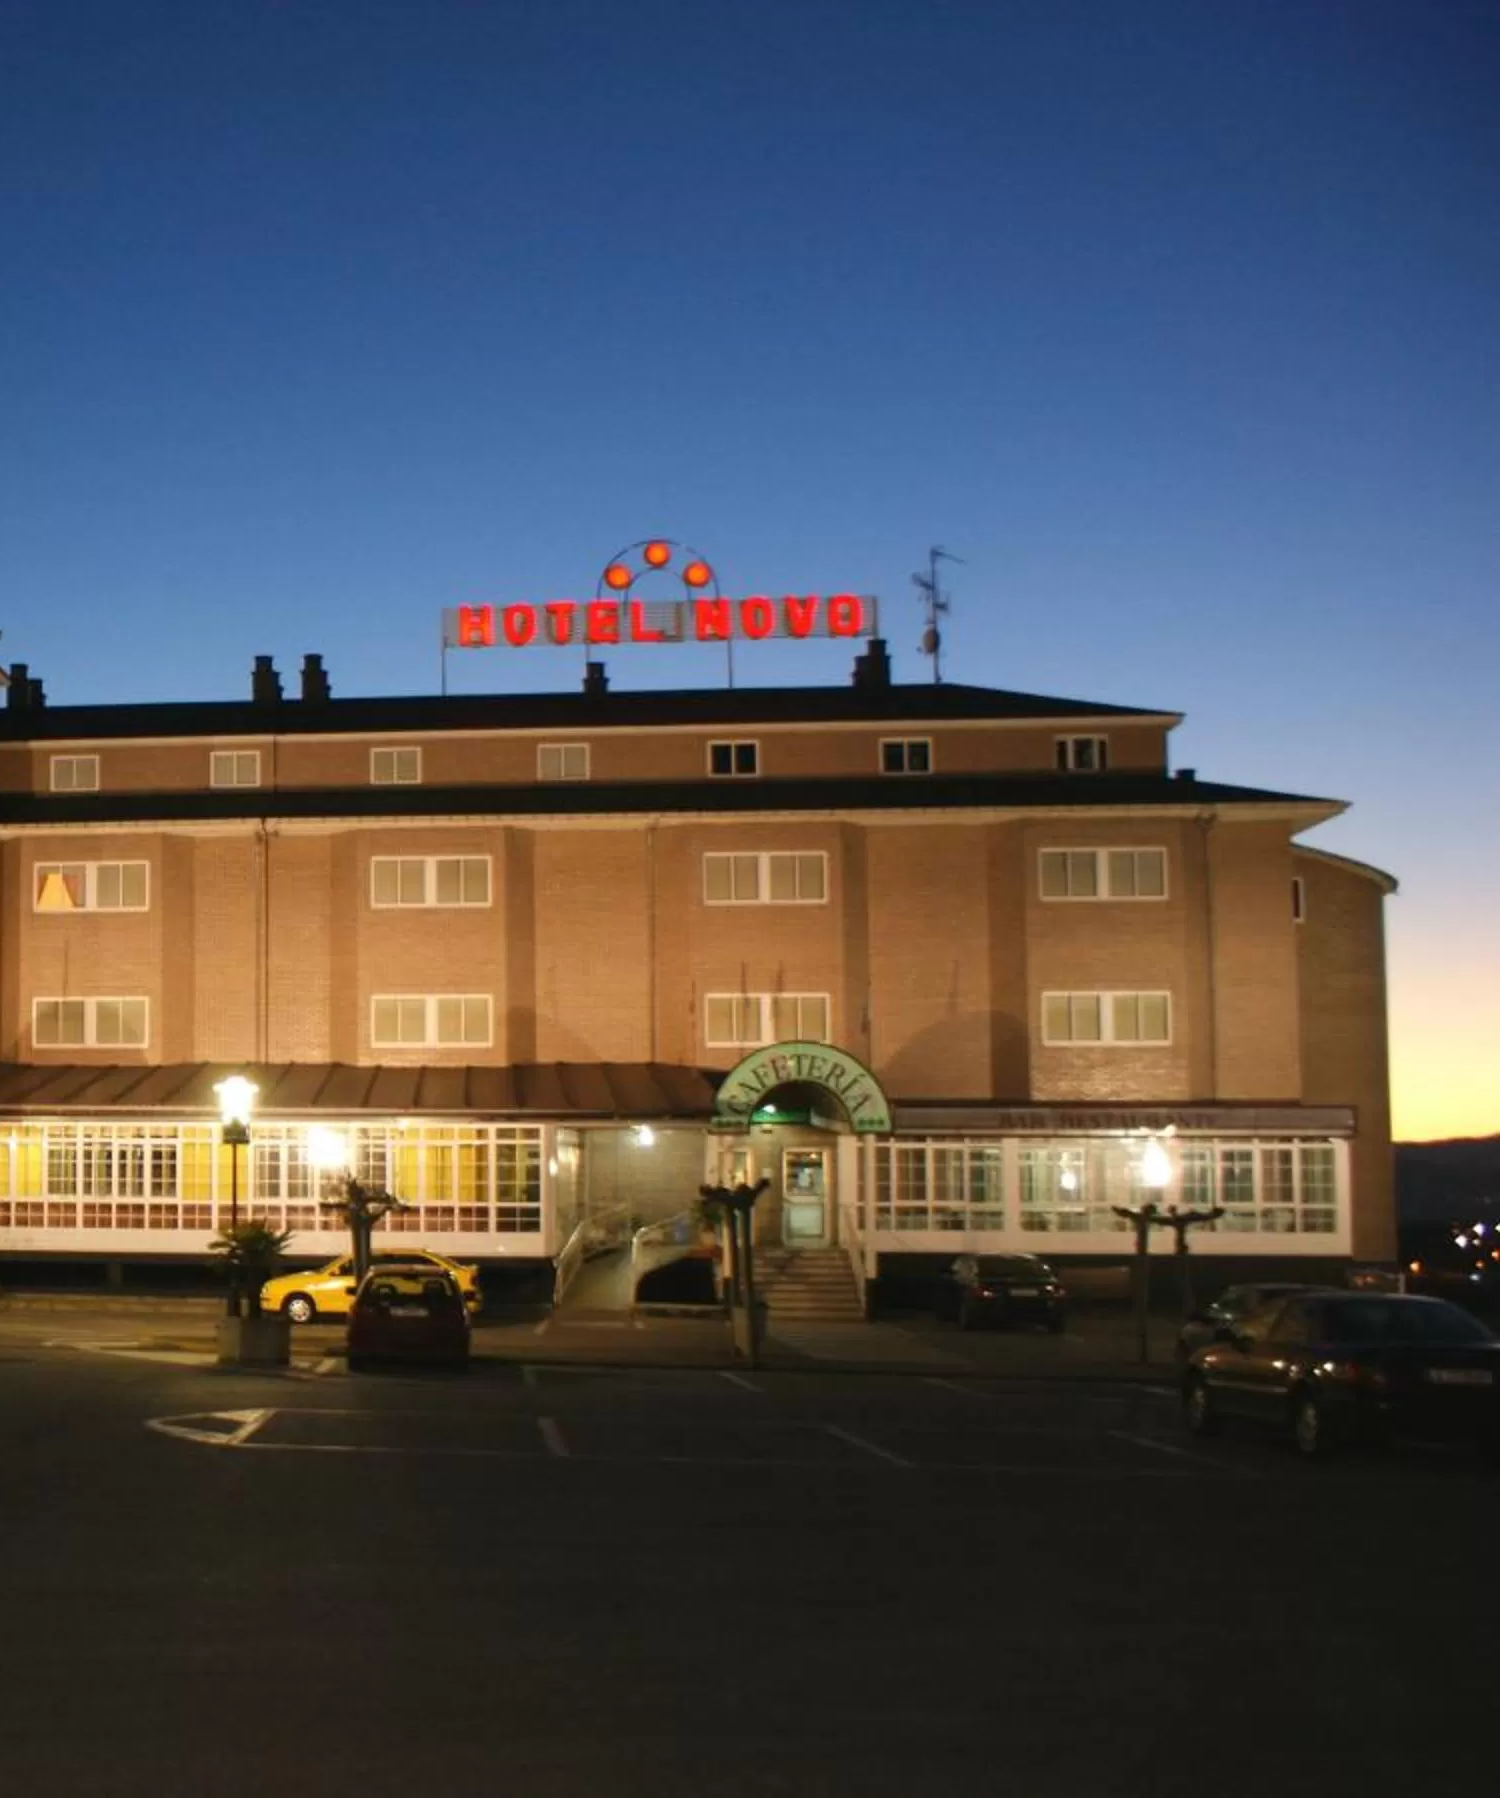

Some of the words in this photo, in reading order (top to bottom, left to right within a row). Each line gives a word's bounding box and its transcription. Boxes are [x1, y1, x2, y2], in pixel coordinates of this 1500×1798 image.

[458, 601, 658, 645] HOTEL
[696, 595, 865, 640] NOVO
[726, 1053, 873, 1115] CAFETERÍA
